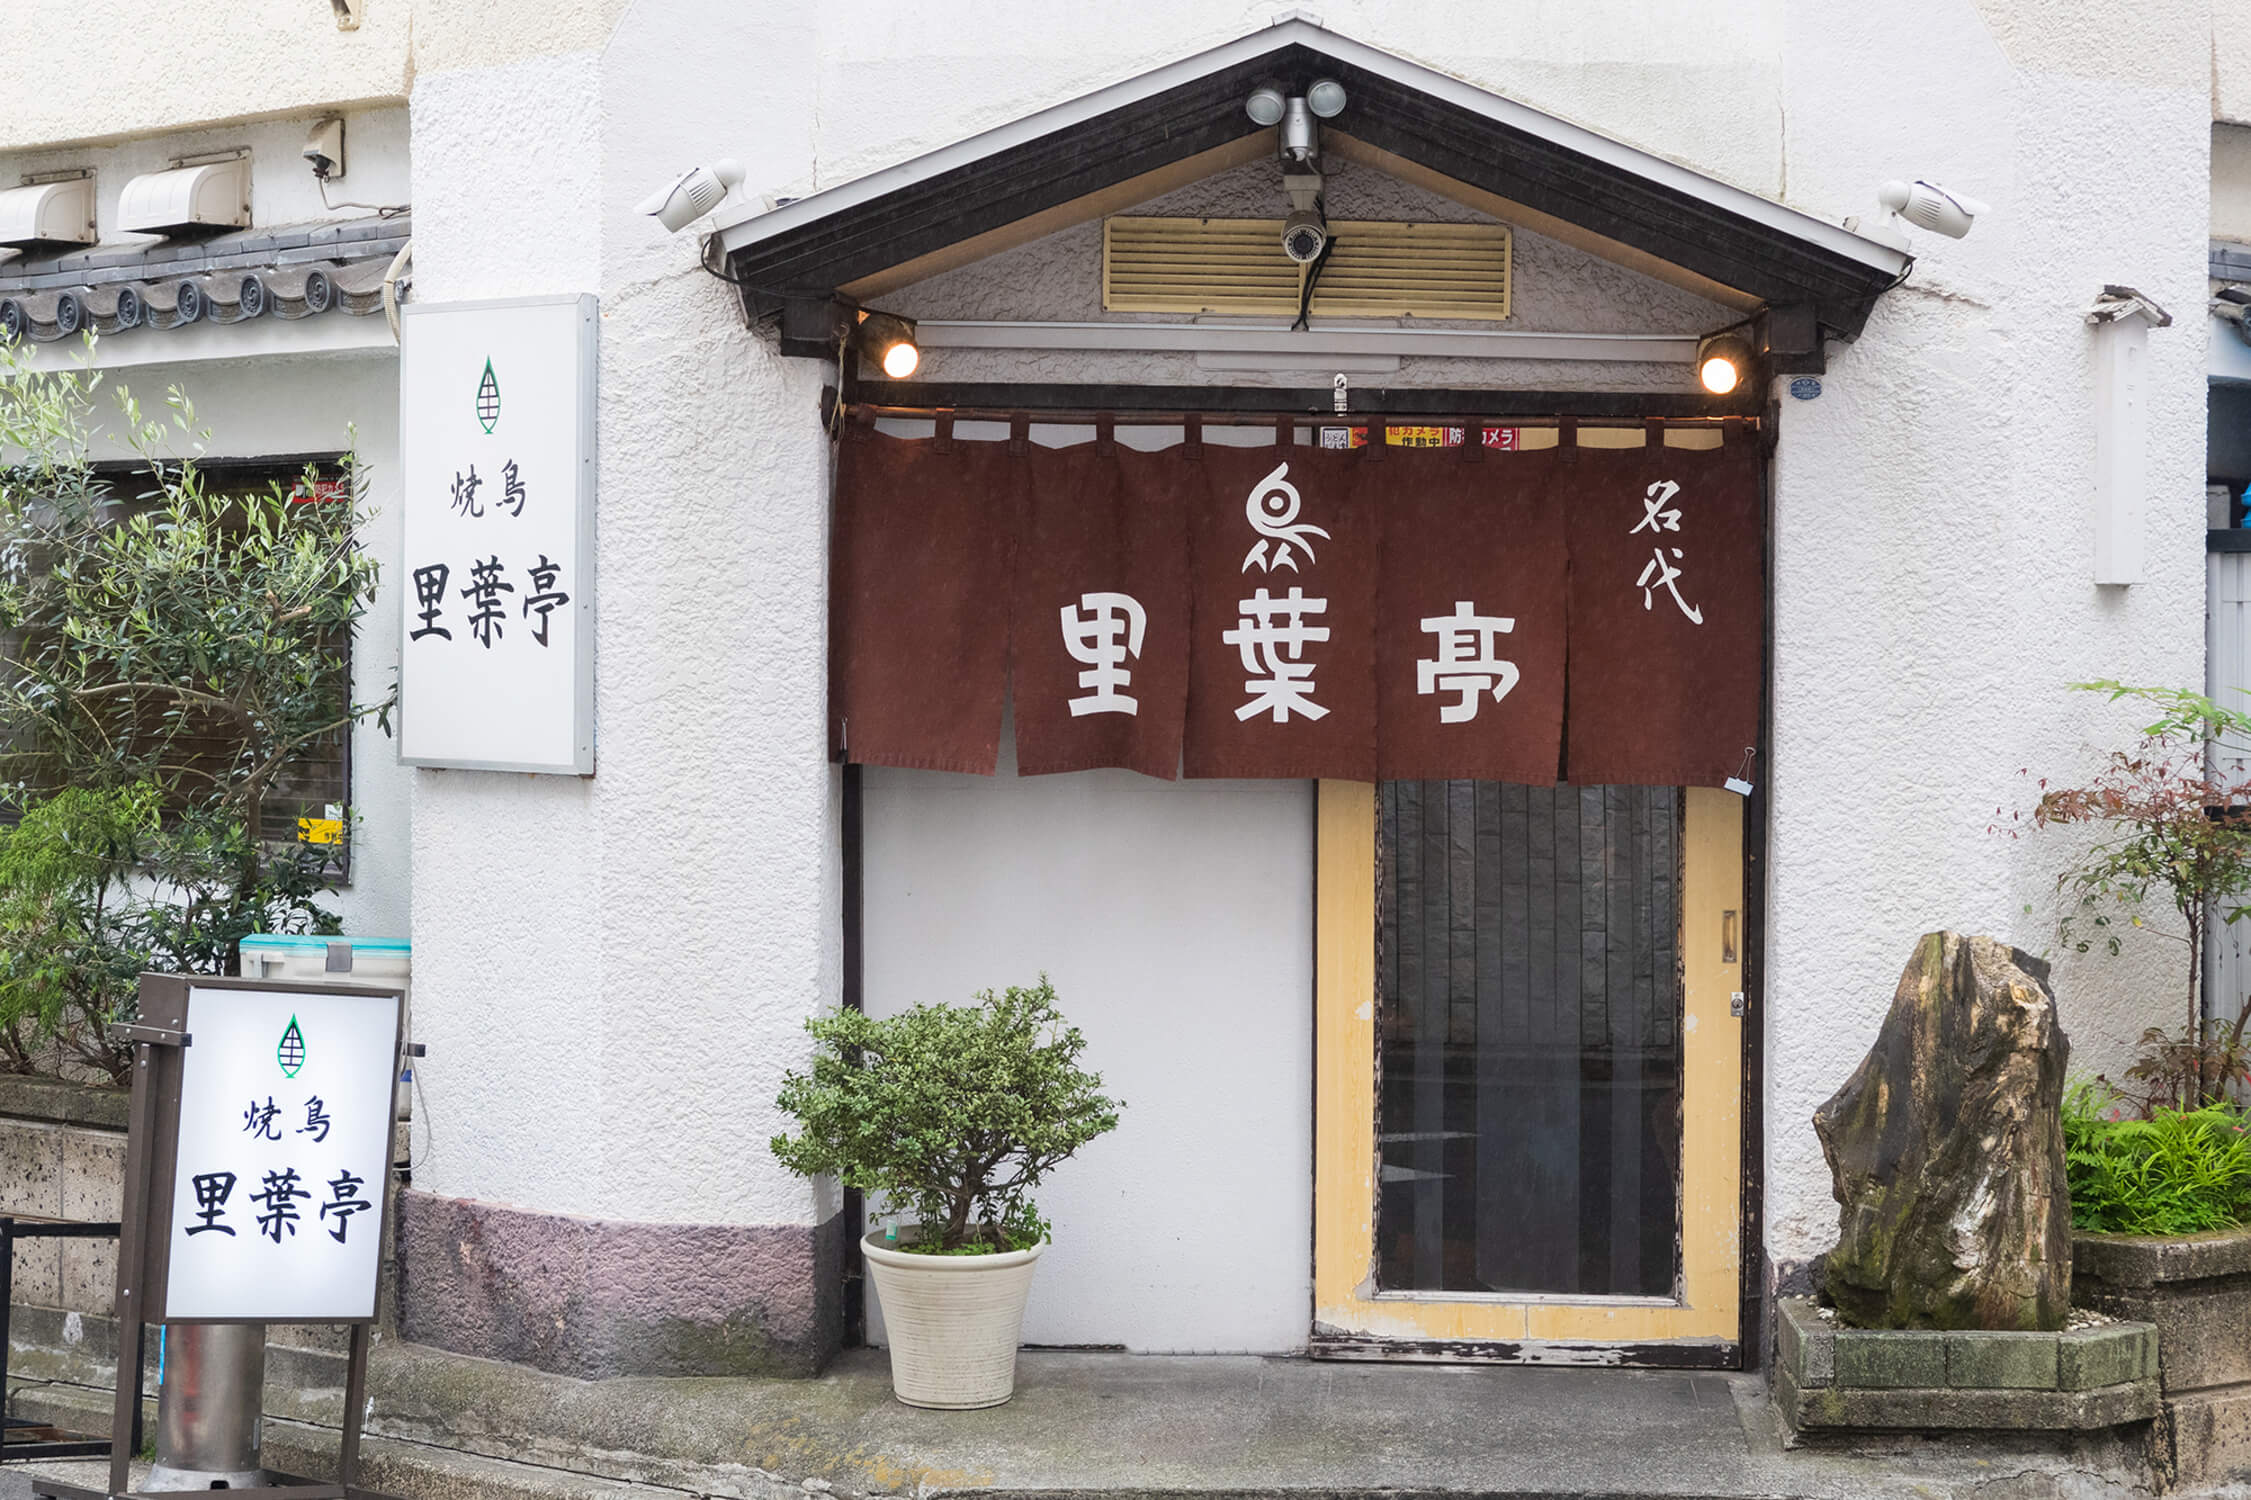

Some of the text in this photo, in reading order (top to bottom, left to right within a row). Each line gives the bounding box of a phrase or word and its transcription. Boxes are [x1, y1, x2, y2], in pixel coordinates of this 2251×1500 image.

[451, 458, 526, 517] 焼鳥
[1630, 480, 1704, 625] 名代
[410, 554, 570, 649] 里葉亭
[1061, 587, 1520, 724] 里葉亭
[243, 1095, 331, 1142] 焼鳥
[185, 1167, 372, 1244] 里葉亭
